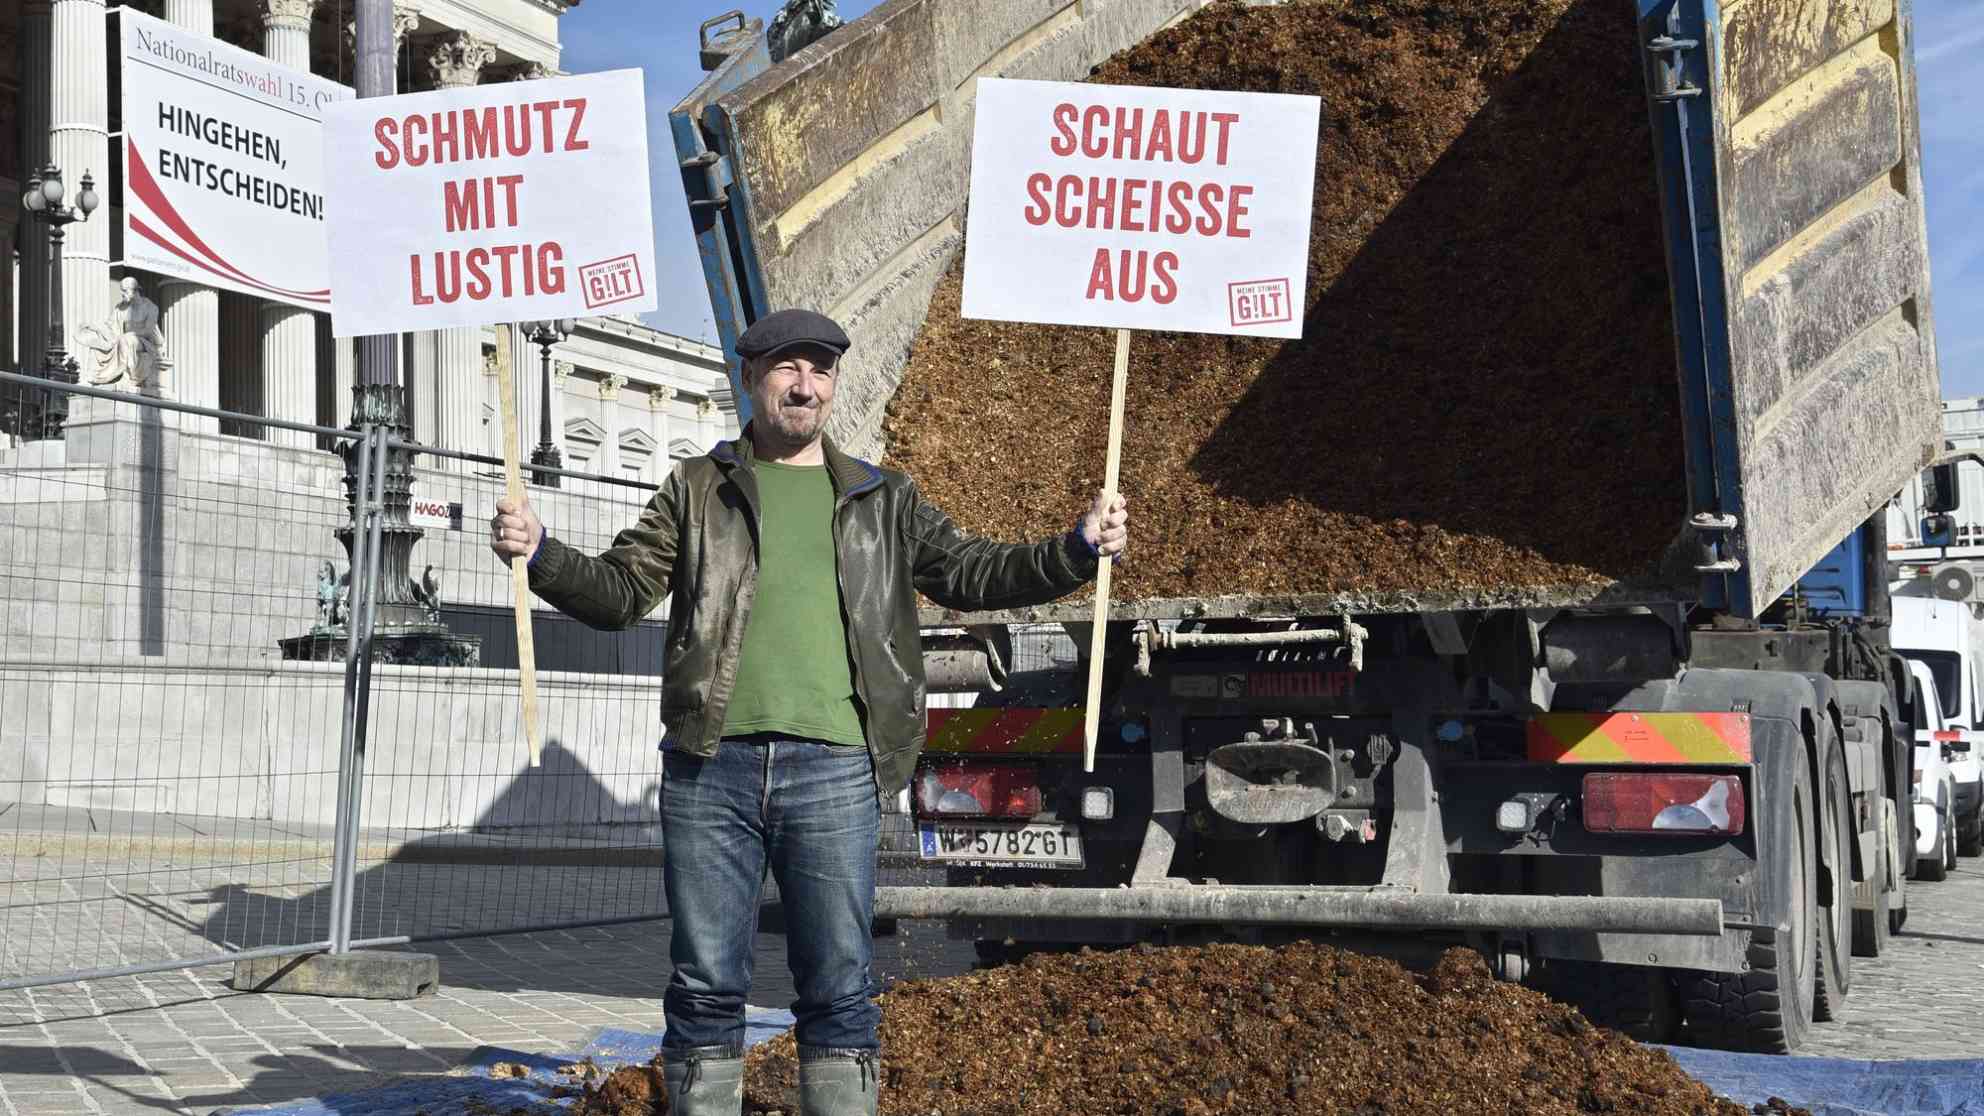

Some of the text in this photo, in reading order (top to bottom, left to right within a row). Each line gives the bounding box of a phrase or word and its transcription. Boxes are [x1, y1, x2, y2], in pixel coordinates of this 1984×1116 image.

[136, 26, 333, 112] Nationalratswahl 15. O
[158, 101, 287, 170] HINGEHEN,
[374, 98, 589, 170] SCHMUTZ
[1050, 103, 1239, 166] SCHAUT
[159, 148, 323, 221] ENTSCHEIDEN!
[444, 174, 524, 232] MIT
[1024, 172, 1254, 238] SCHEISSE
[410, 241, 565, 305] LUSTIG
[590, 268, 632, 301] G!LT
[1085, 248, 1179, 305] AUS
[1238, 292, 1282, 320] G!LT
[975, 830, 1035, 855] 5782
[1043, 830, 1071, 856] GT
